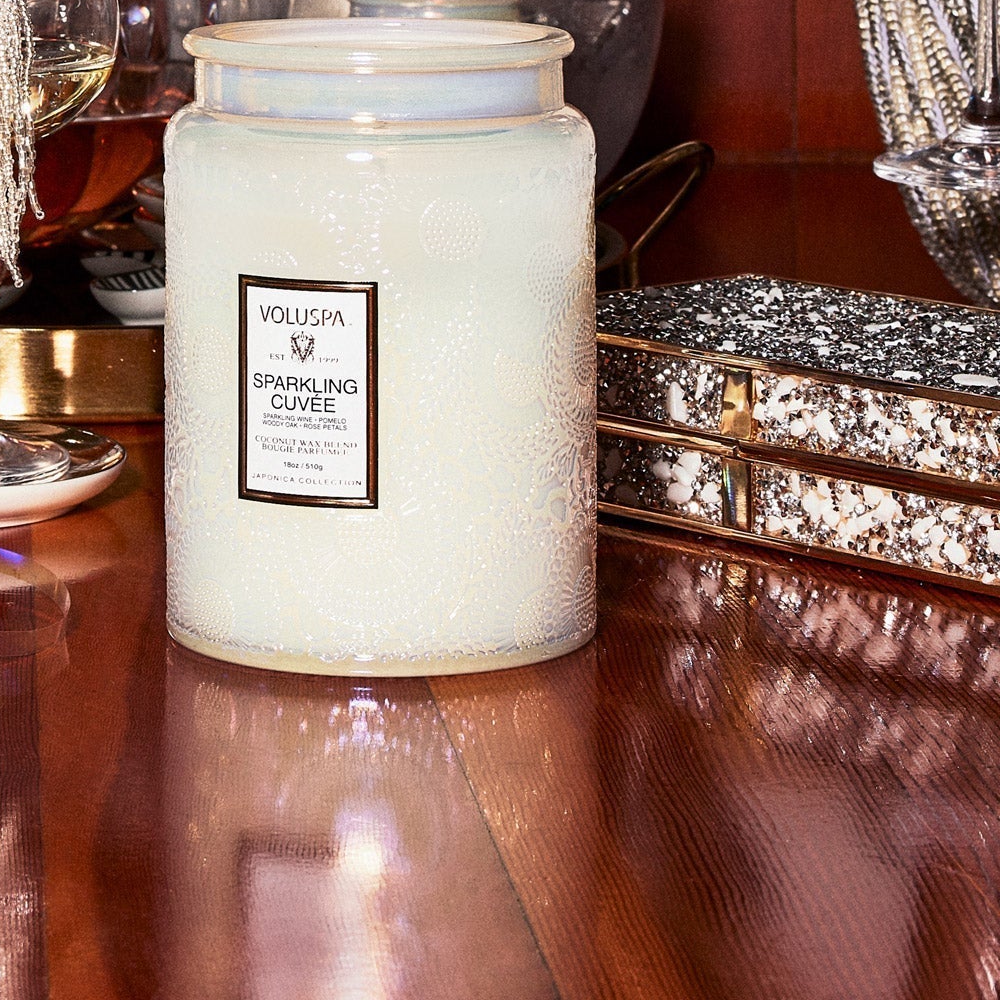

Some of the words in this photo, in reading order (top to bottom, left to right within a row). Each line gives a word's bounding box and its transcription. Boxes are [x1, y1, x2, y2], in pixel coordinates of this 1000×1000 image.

[260, 304, 345, 327] VOLUSPA
[253, 372, 358, 394] SPARKLING
[271, 393, 336, 413] CUVÉE
[262, 413, 295, 422] SPARKLING
[297, 415, 312, 423] WINE
[255, 435, 296, 446] COCONUT
[299, 439, 322, 448] WAX
[261, 443, 295, 454] BOUGIE
[283, 461, 299, 469] 18oz
[305, 462, 323, 471] 510g
[251, 473, 295, 483] JAPONICA
[298, 477, 362, 486] COLLECTION
